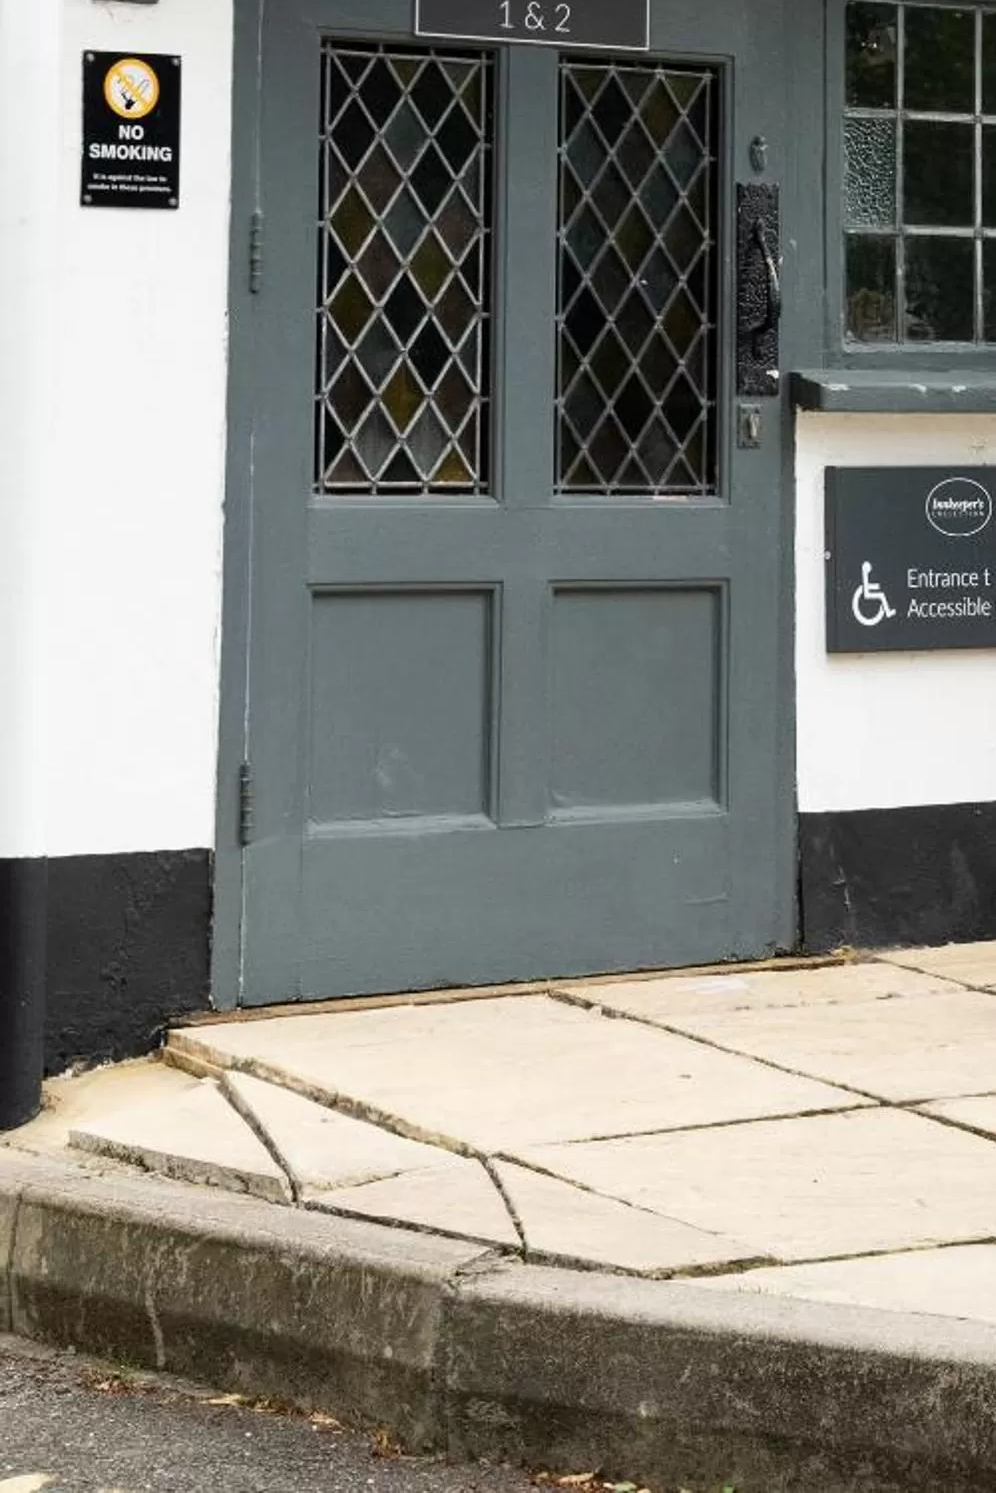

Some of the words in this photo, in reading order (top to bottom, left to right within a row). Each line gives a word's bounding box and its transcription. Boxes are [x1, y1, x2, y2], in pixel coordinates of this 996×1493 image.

[499, 0, 516, 29] 1
[524, 1, 547, 31] &
[554, 3, 571, 33] 2
[118, 124, 144, 140] NO
[89, 143, 172, 162] SMOKING
[907, 568, 979, 588] Entrance
[907, 597, 992, 618] Accessible
